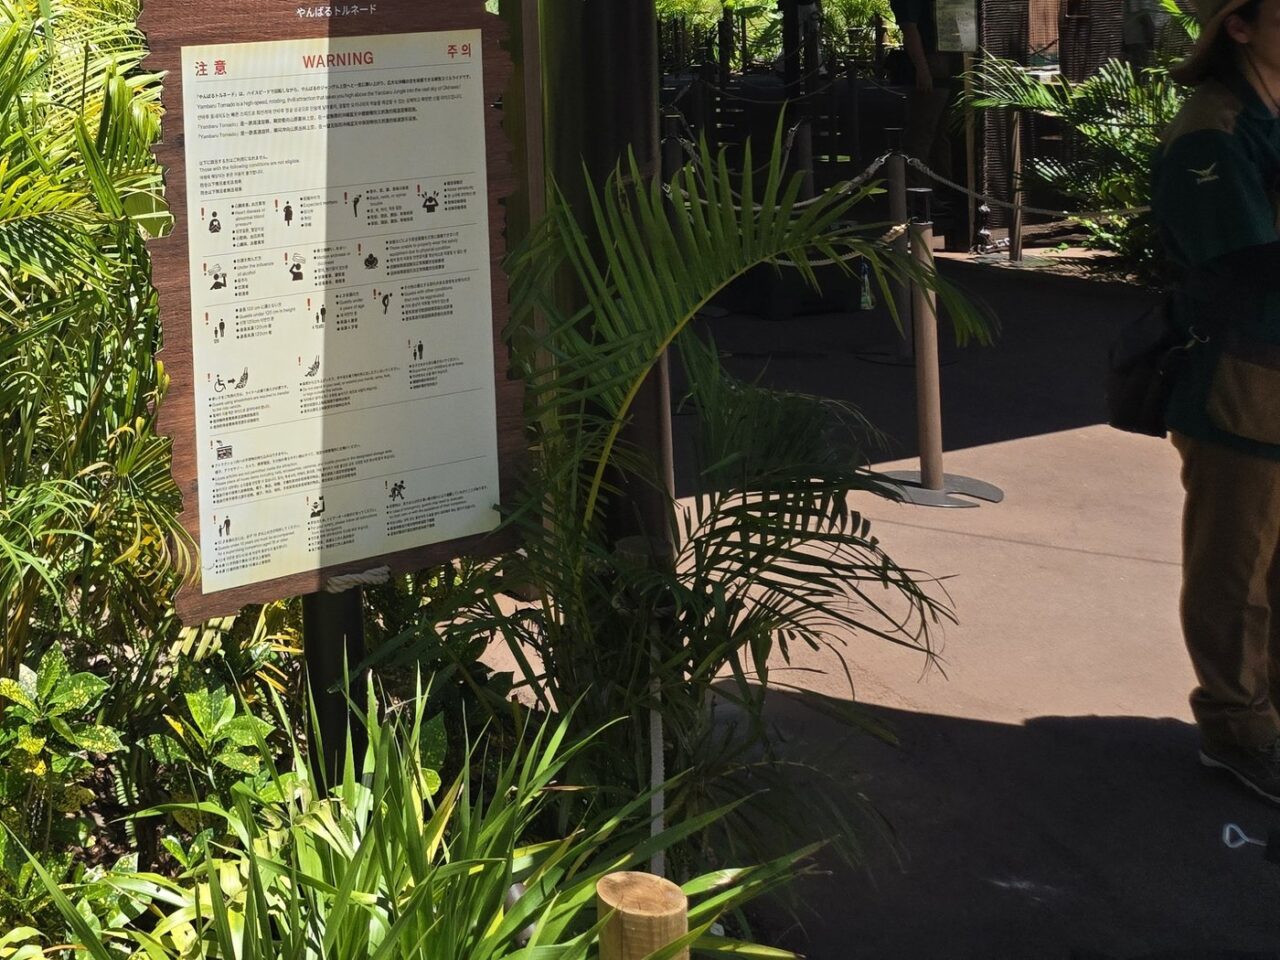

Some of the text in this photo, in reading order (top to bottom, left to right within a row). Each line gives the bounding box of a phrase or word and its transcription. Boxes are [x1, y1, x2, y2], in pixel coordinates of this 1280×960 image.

[297, 4, 377, 19] やんばるトルネード
[195, 60, 227, 76] 注意
[303, 51, 374, 69] WARNING
